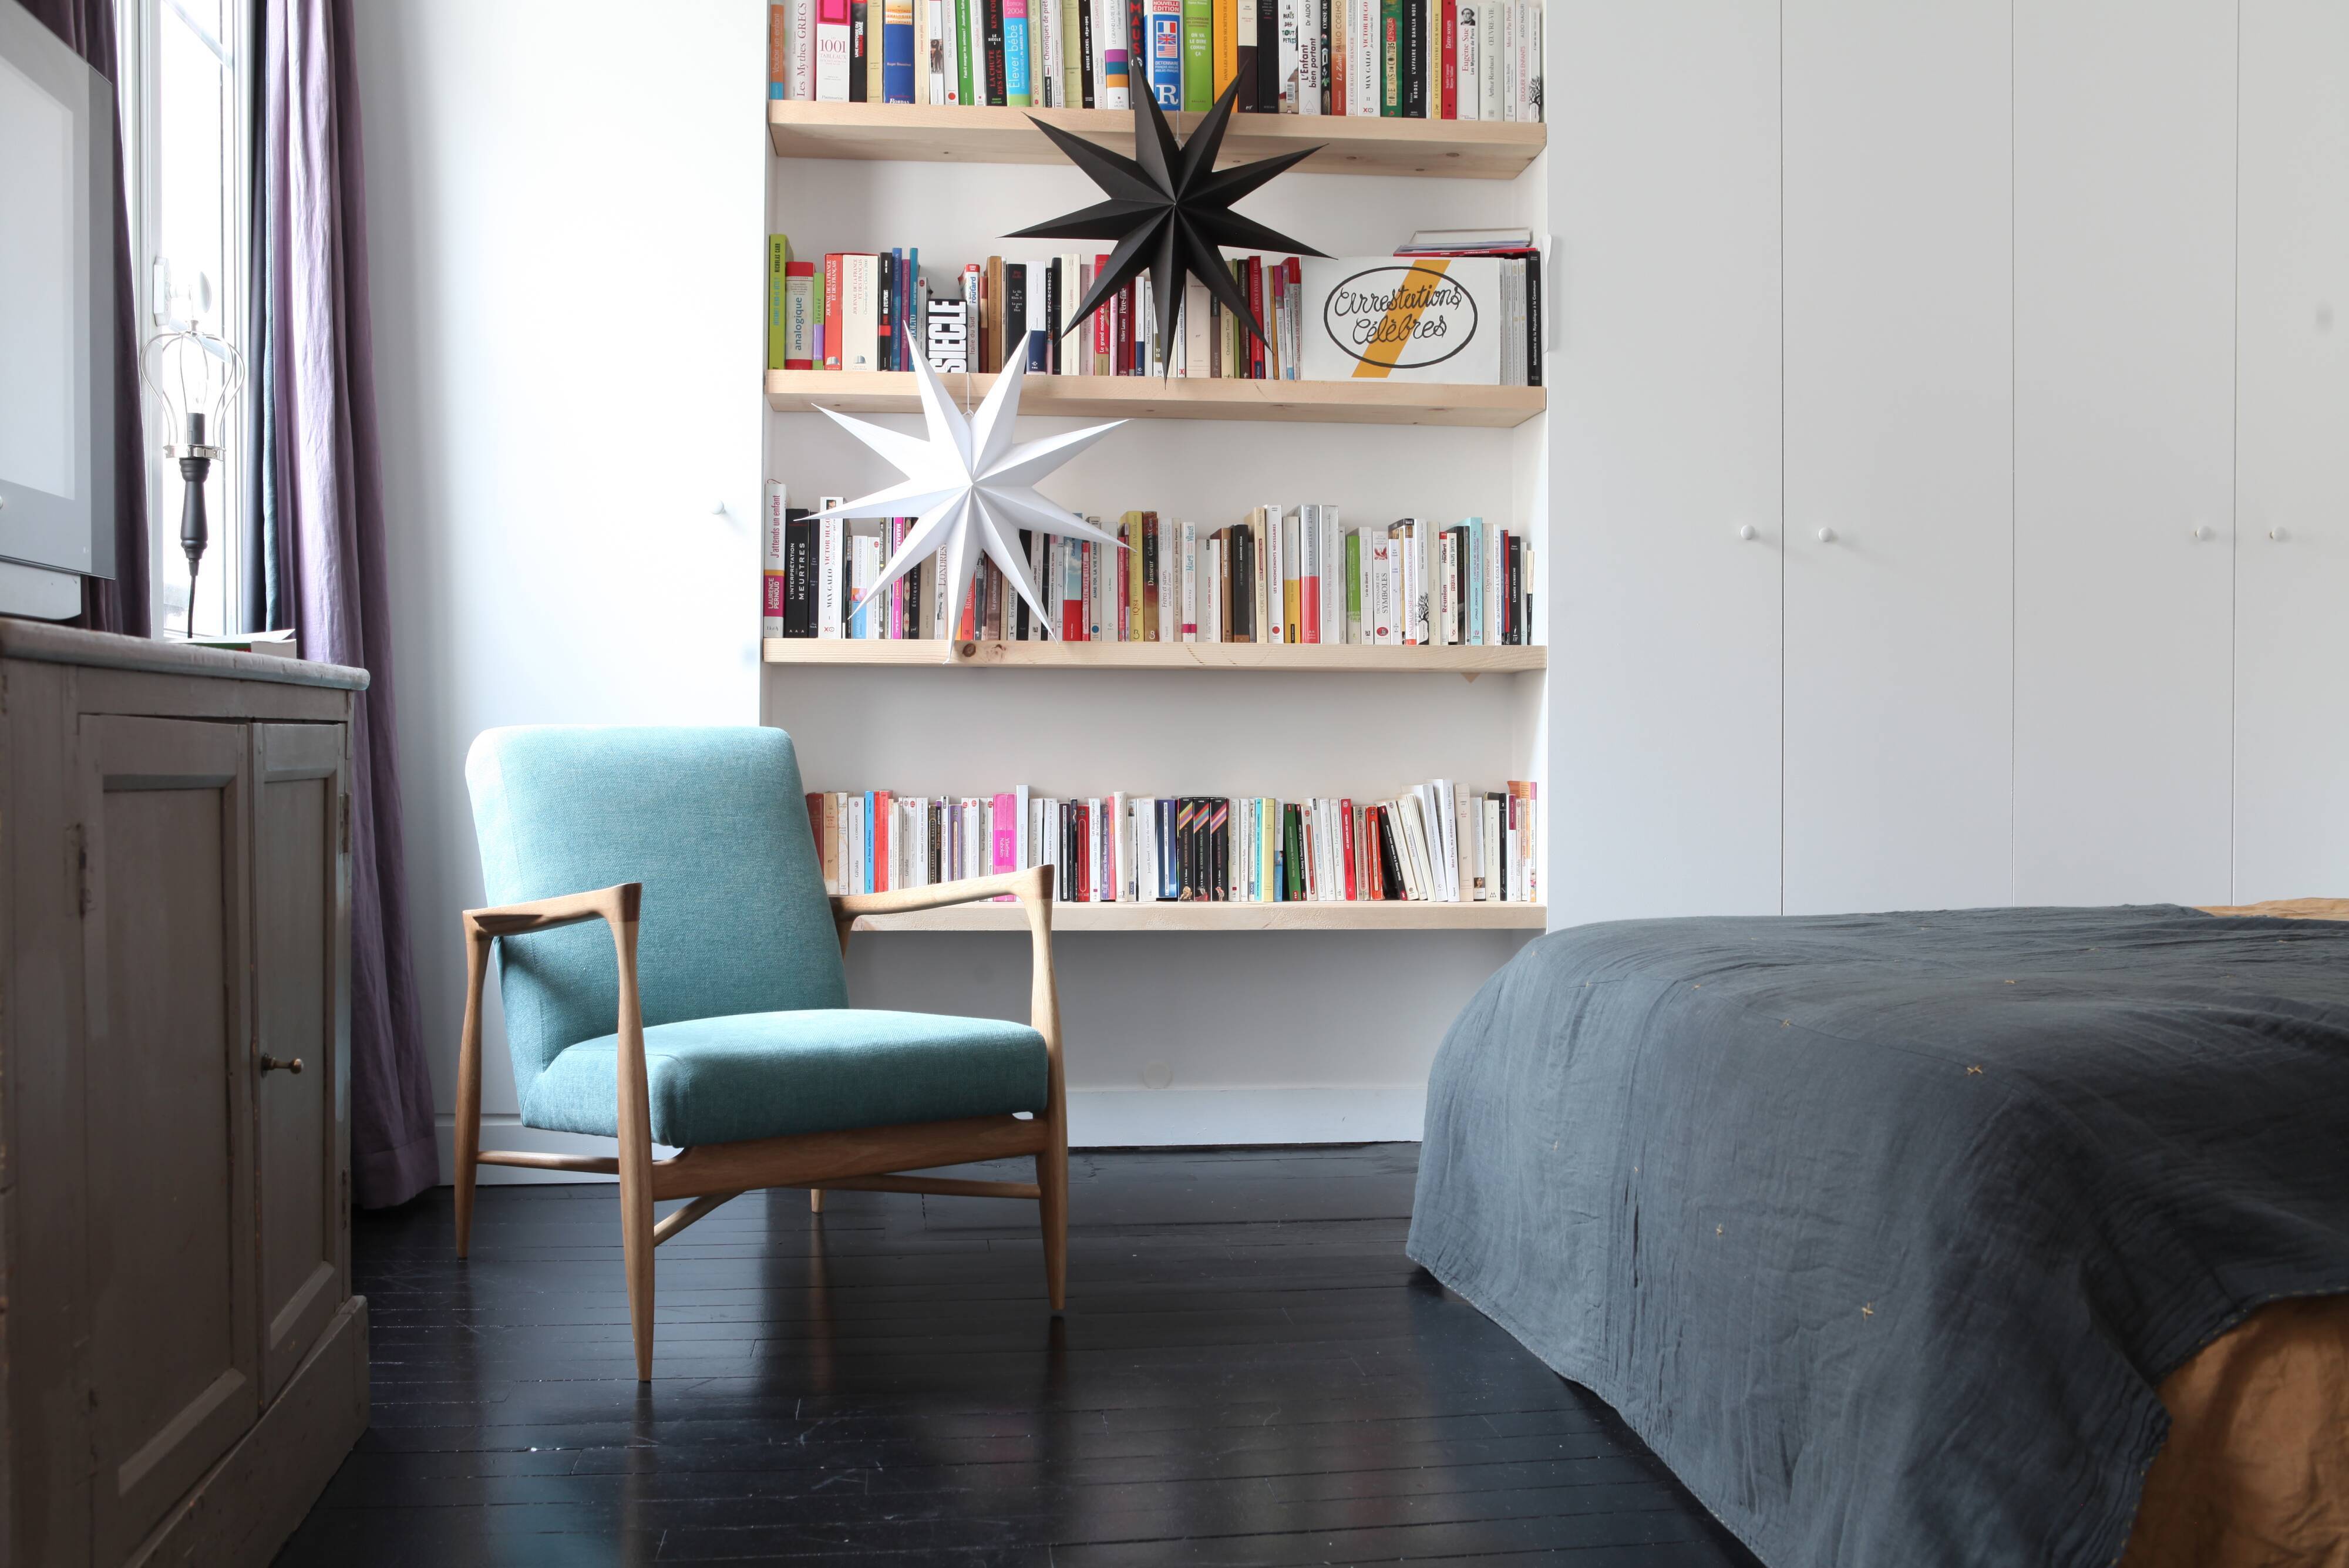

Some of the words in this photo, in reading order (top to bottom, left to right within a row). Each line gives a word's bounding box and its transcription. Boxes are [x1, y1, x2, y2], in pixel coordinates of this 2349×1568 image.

[797, 2, 806, 39] GRECS
[1130, 3, 1141, 54] MAUS
[820, 39, 846, 53] 1001
[1007, 25, 1019, 52] bébé
[1309, 38, 1318, 68] portant
[797, 43, 808, 76] Mythes
[1007, 56, 1019, 88] Élever
[1300, 45, 1308, 80] L'Enfant
[797, 82, 806, 96] Les
[990, 78, 996, 87] LA
[1309, 70, 1318, 88] bien
[1156, 85, 1178, 105] R
[1335, 284, 1462, 316] Arrestations
[794, 297, 804, 350] analogique
[928, 301, 966, 372] SIECLE
[1353, 315, 1447, 345] Célèbres
[772, 495, 780, 516] enfant
[772, 528, 780, 558] J'attends
[938, 546, 946, 586] LONDRES
